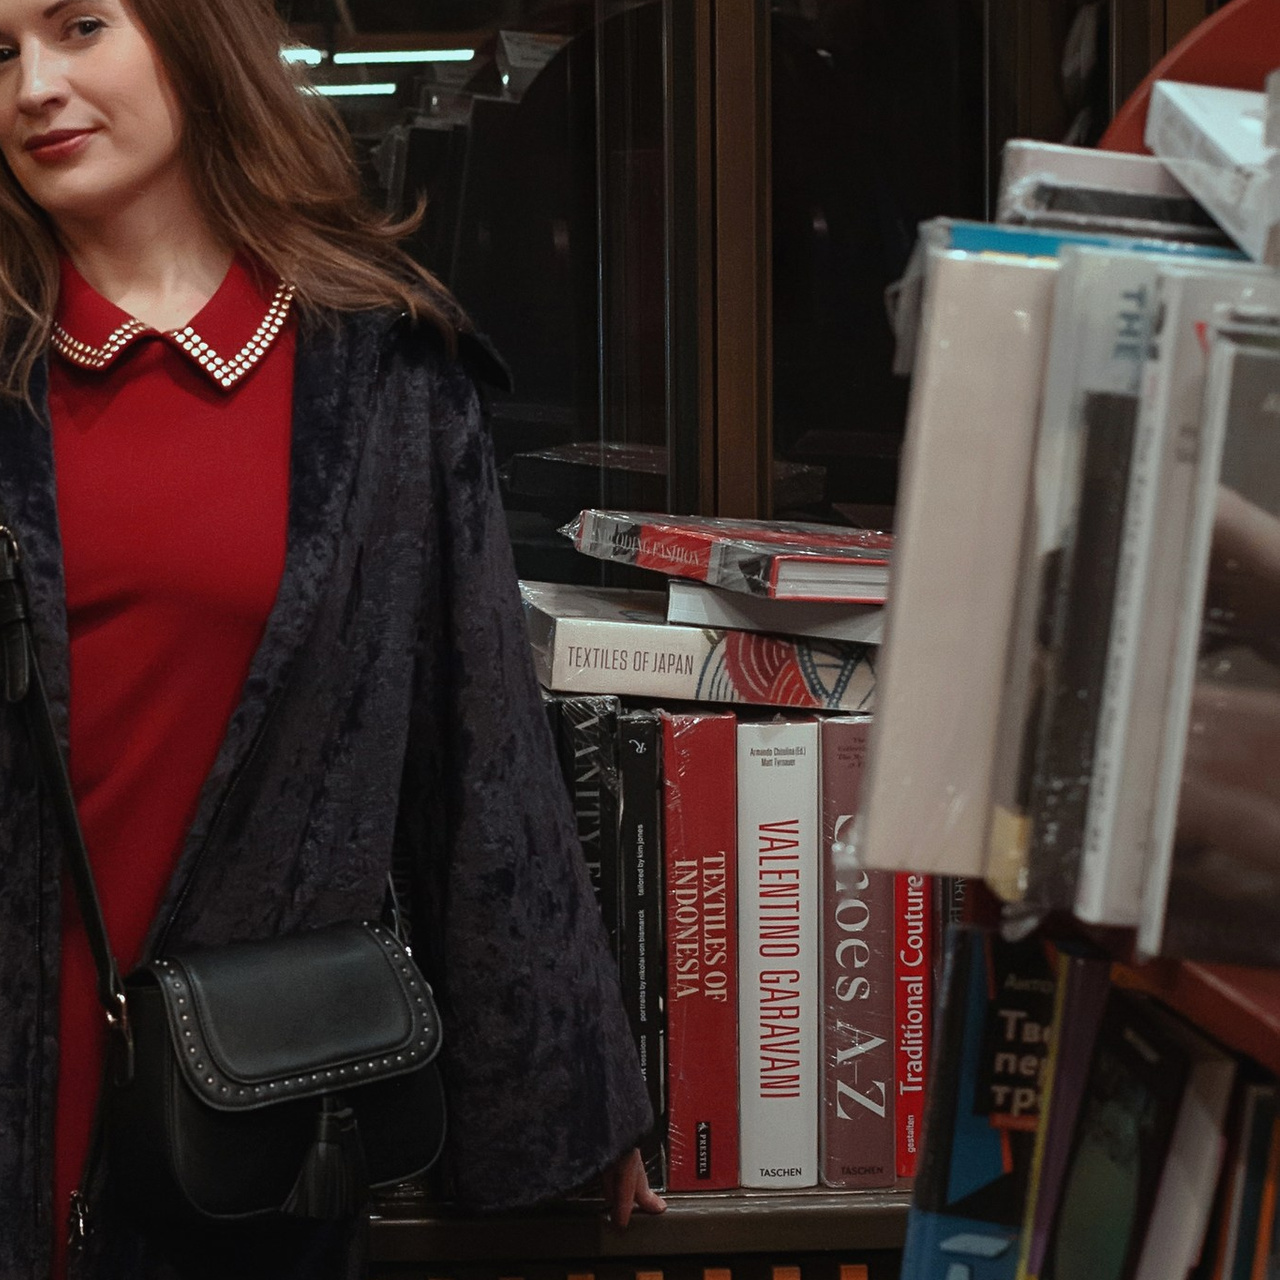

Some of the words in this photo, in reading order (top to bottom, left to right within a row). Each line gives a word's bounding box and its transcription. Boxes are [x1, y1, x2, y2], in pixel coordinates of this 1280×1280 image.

[652, 541, 700, 566] FASHION
[567, 646, 629, 669] TEXTILES
[632, 650, 650, 671] OF
[651, 651, 695, 676] JAPAN
[572, 716, 603, 855] VANITY
[636, 825, 646, 845] jones
[636, 846, 645, 859] kim
[636, 870, 645, 895] tailored
[757, 818, 800, 958] VALENTINO
[703, 852, 727, 966] TEXTILES
[899, 875, 925, 967] Couture
[673, 859, 701, 999] INDONESIA
[704, 970, 728, 1003] OF
[759, 970, 801, 1099] GARAVANI
[899, 974, 925, 1096] Traditional
[904, 1114, 916, 1153] gestalten
[697, 1133, 709, 1174] PRESTEL
[759, 1167, 803, 1178] TASCHEN
[840, 1166, 884, 1176] TASCHEN
